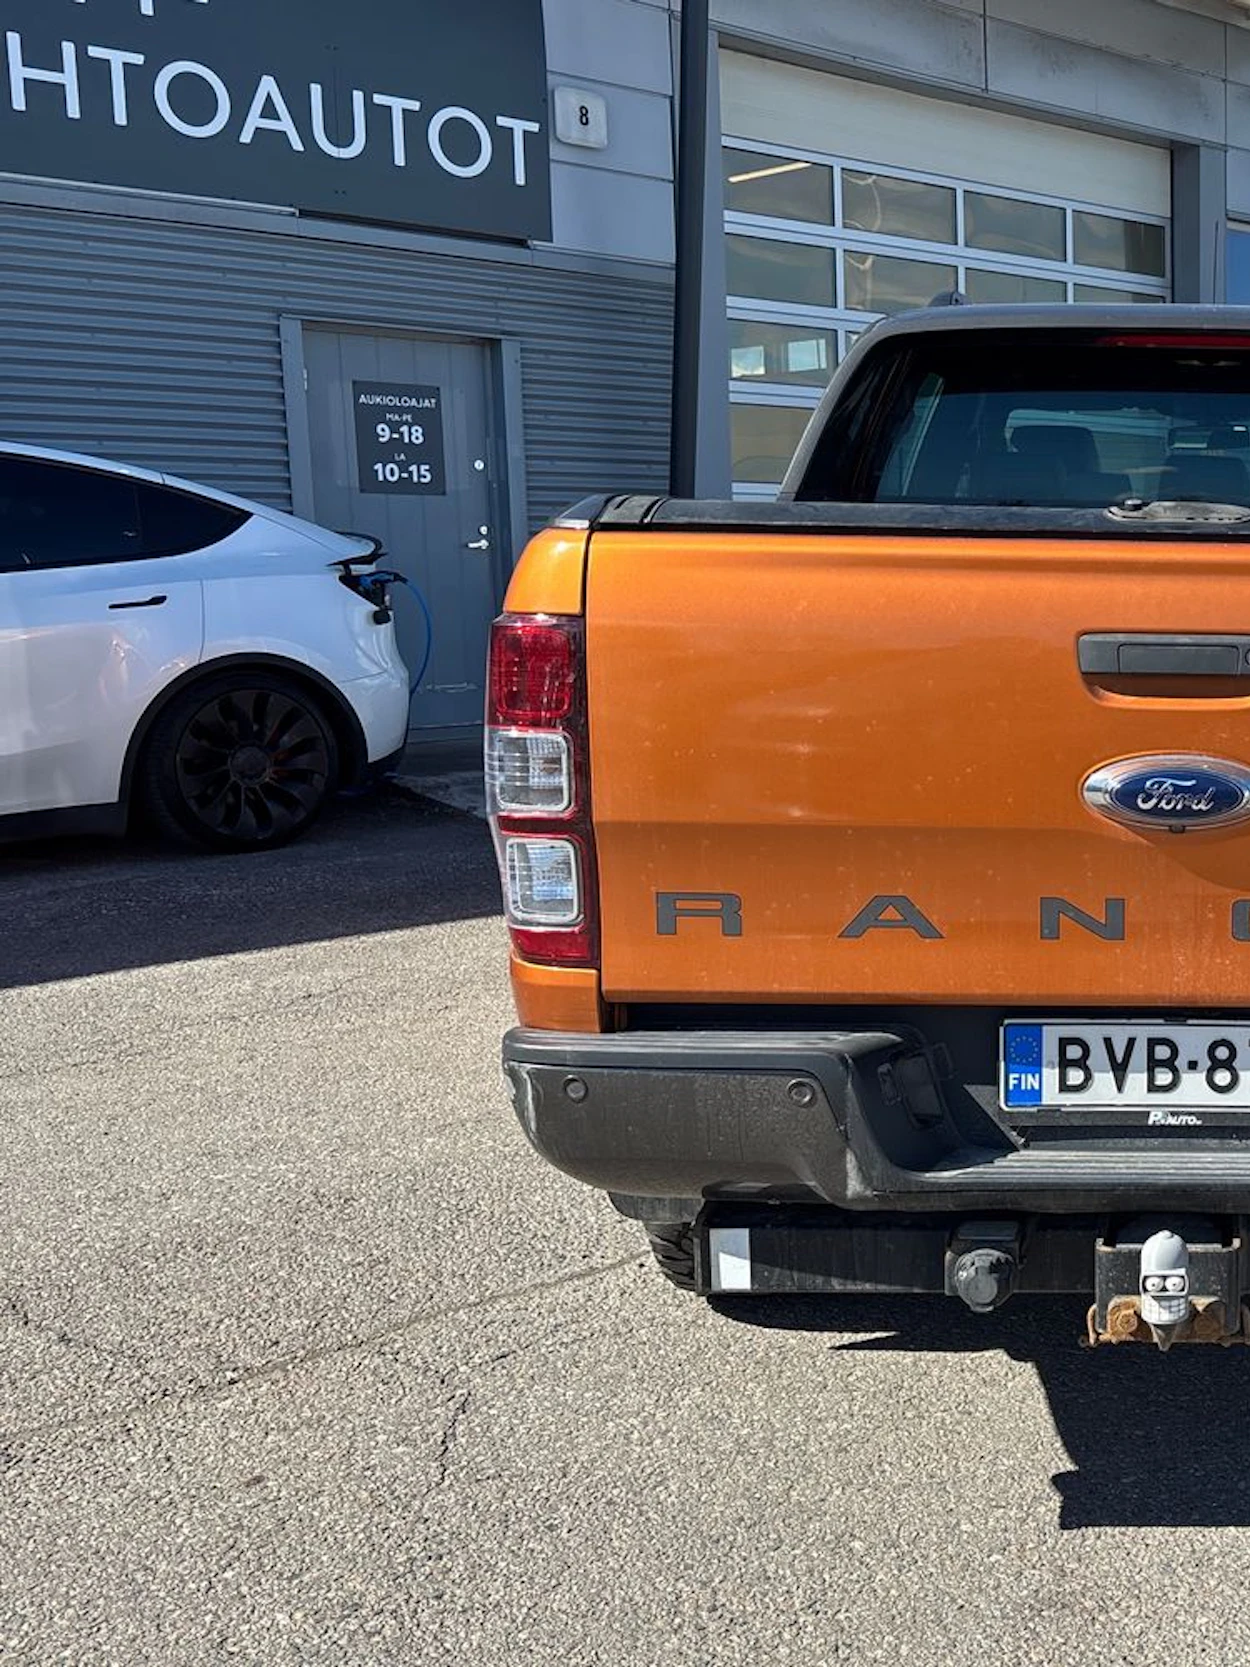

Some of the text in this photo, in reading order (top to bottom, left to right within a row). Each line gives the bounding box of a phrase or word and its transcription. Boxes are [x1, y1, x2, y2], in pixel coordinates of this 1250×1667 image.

[5, 30, 541, 187] HTOAUTOT
[579, 105, 589, 126] 8
[359, 394, 437, 408] AUKIOLOAJAT
[375, 422, 425, 445] 9-18
[394, 452, 407, 462] LA
[373, 462, 432, 484] 10-15
[1135, 776, 1217, 812] Ford
[1008, 1072, 1041, 1091] FIN
